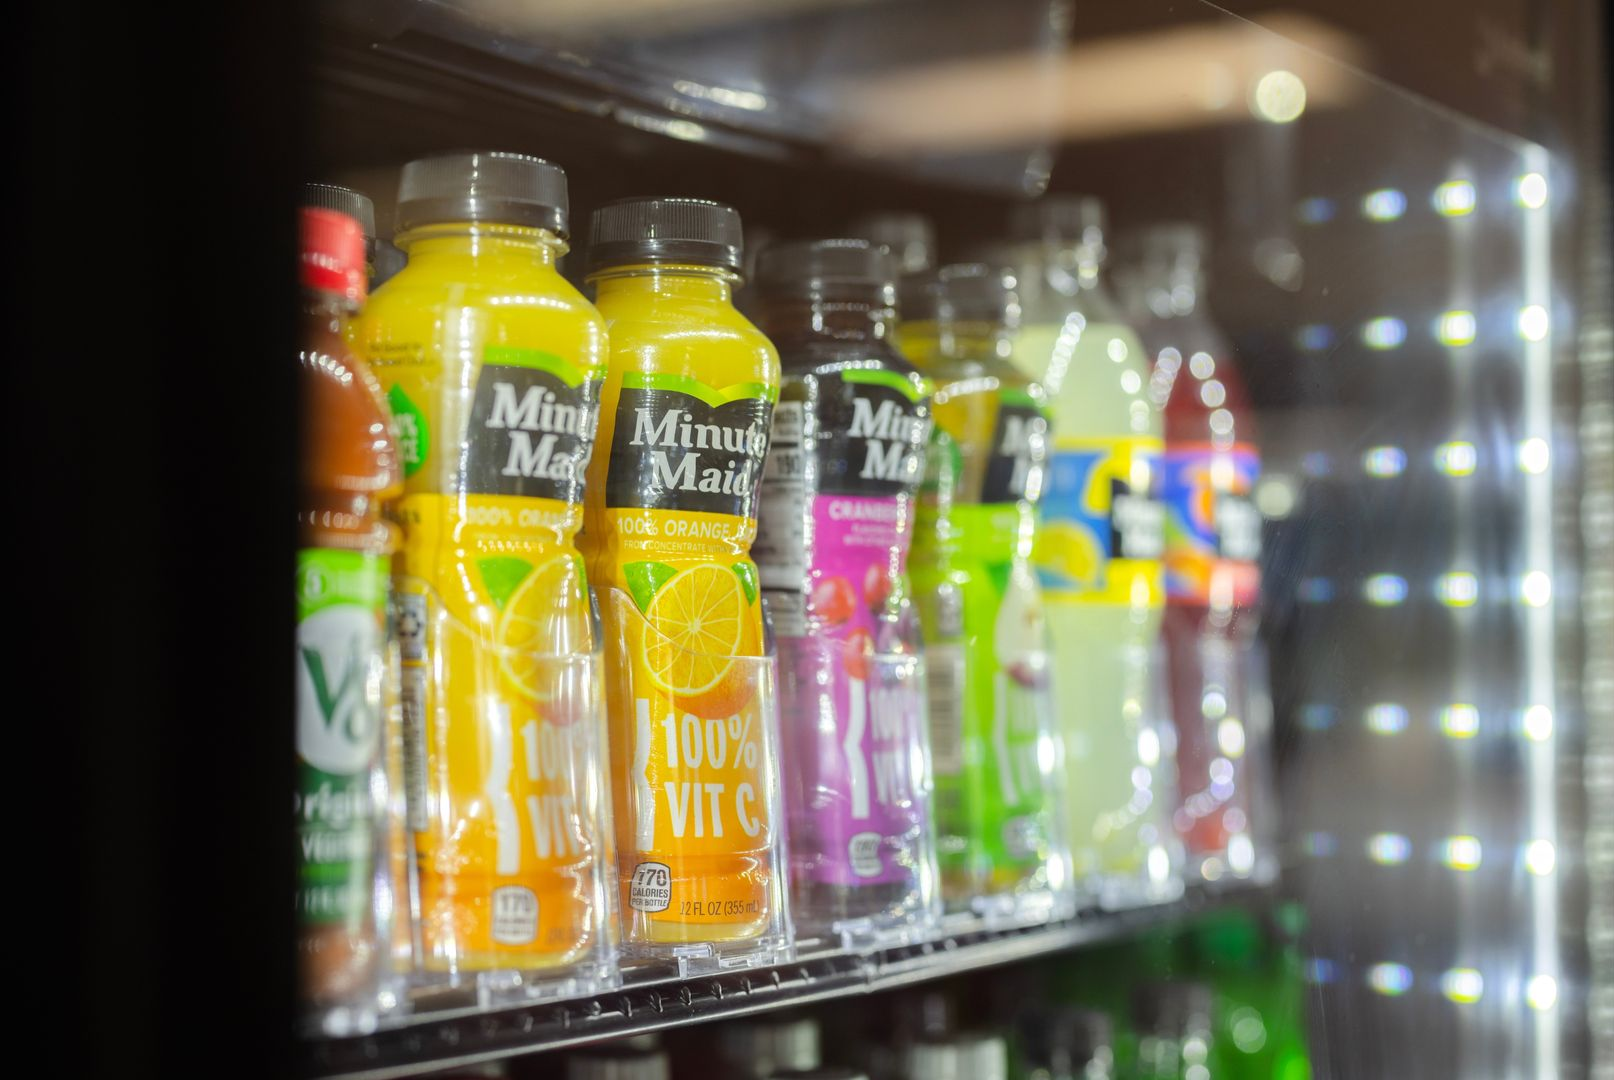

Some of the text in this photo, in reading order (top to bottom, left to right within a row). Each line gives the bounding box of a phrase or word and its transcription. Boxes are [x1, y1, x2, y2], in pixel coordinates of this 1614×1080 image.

[629, 408, 767, 458] Minute
[650, 451, 753, 496] Maid
[617, 516, 659, 536] 100%
[664, 519, 731, 541] ORANGE
[661, 713, 758, 769] 100%
[664, 782, 761, 838] VIT C
[632, 887, 669, 899] CALORIES
[645, 899, 668, 907] BOTTLE
[680, 901, 692, 916] 12
[693, 901, 706, 916] FL
[707, 901, 722, 916] OZ
[723, 901, 745, 917] (355
